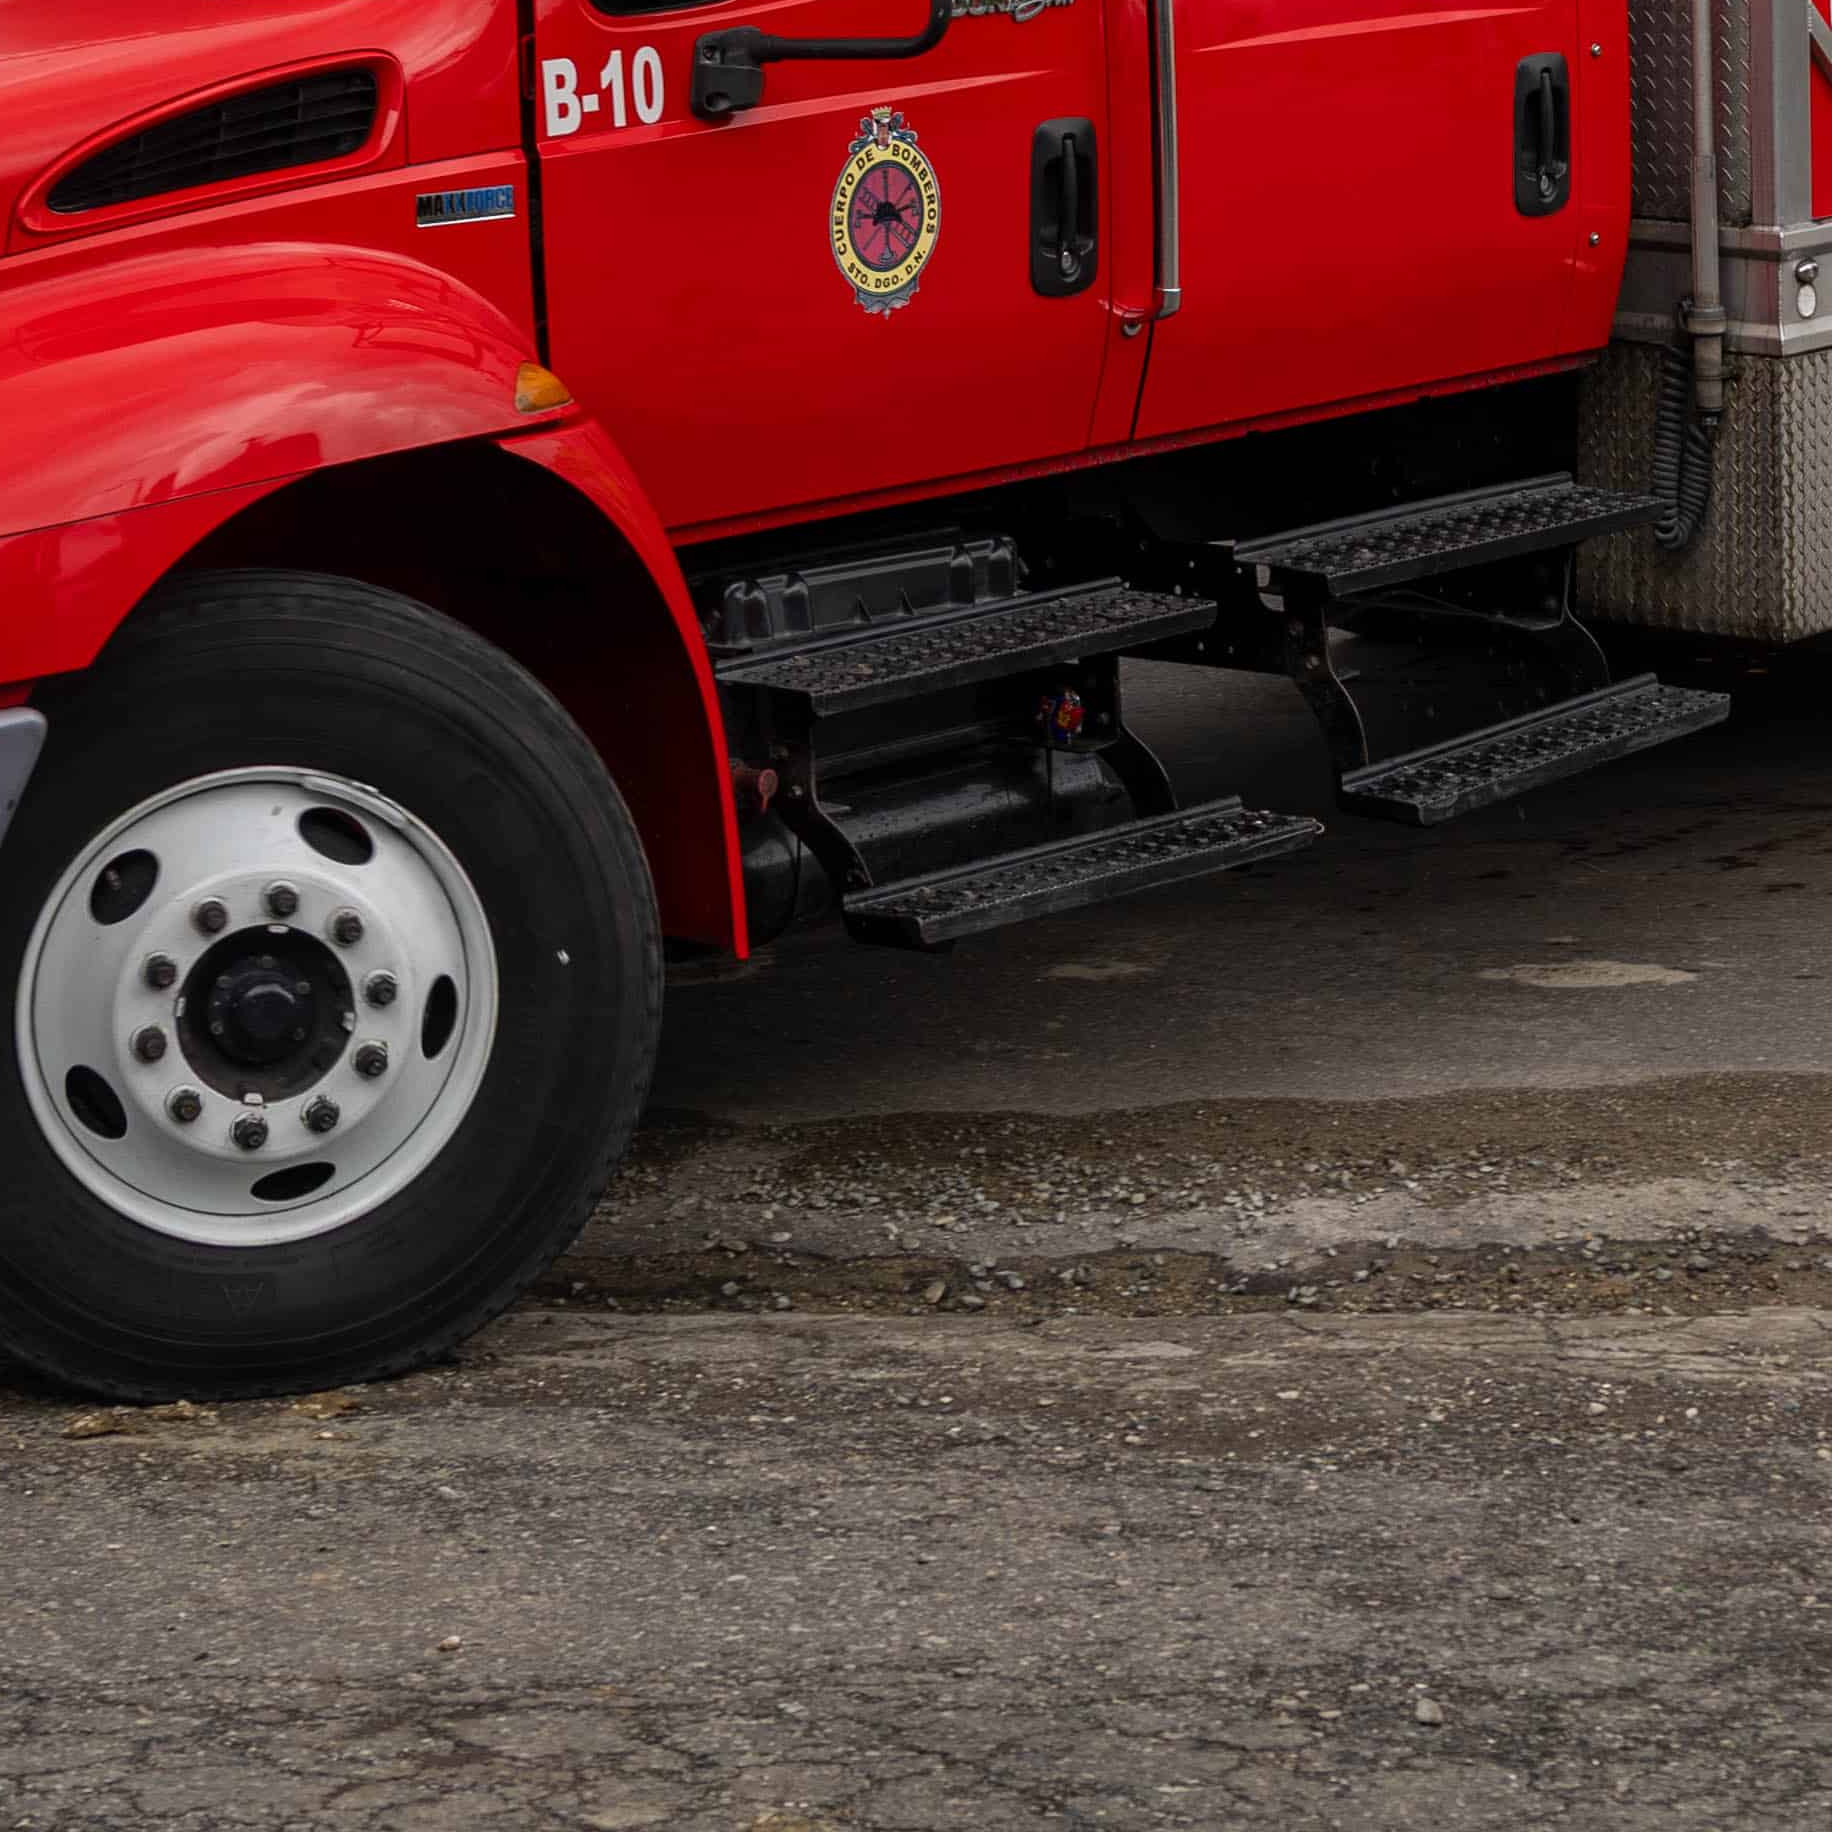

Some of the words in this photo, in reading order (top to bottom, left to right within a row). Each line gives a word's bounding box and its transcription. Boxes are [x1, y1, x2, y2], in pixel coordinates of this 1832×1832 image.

[542, 46, 664, 137] B-10
[835, 173, 856, 255] CUERPO
[856, 148, 875, 169] DE
[891, 143, 937, 234] BOMBEROS
[848, 262, 871, 287] STO.
[874, 277, 904, 289] DGO.
